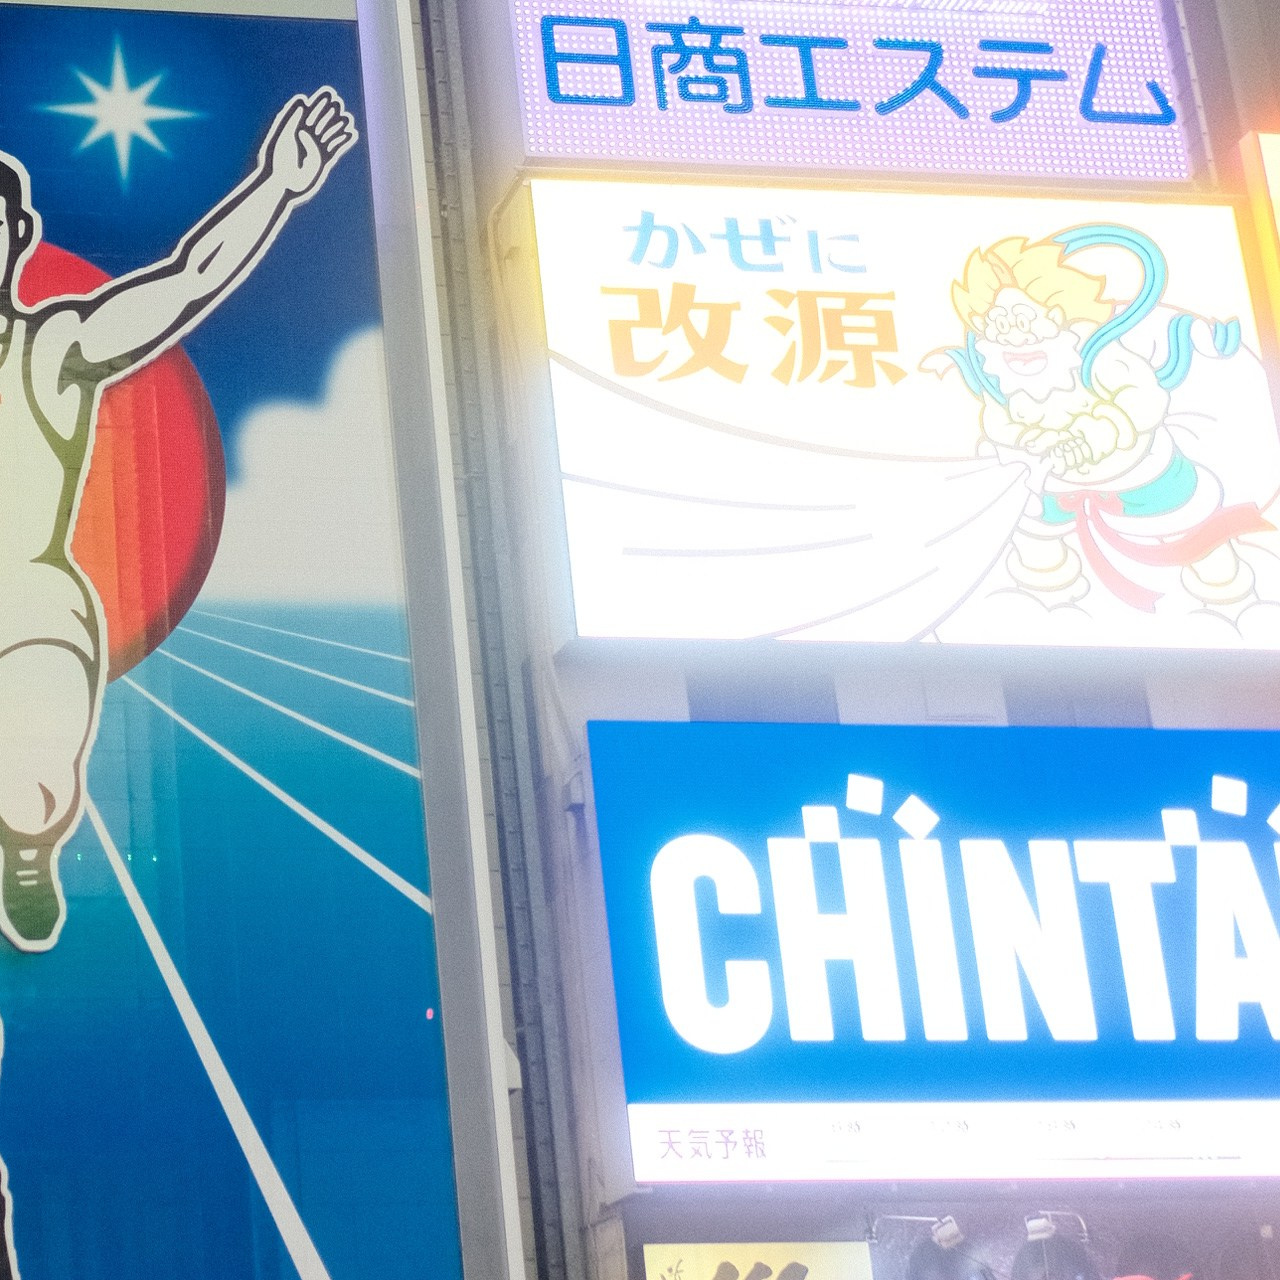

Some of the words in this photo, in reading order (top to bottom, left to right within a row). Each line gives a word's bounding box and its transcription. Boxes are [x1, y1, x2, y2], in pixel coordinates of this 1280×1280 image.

[540, 13, 1177, 127] 日商エステム
[623, 209, 868, 275] かぜに
[600, 282, 909, 389] 改源
[650, 774, 1280, 1054] CHINTA
[658, 1128, 767, 1160] 天気予報
